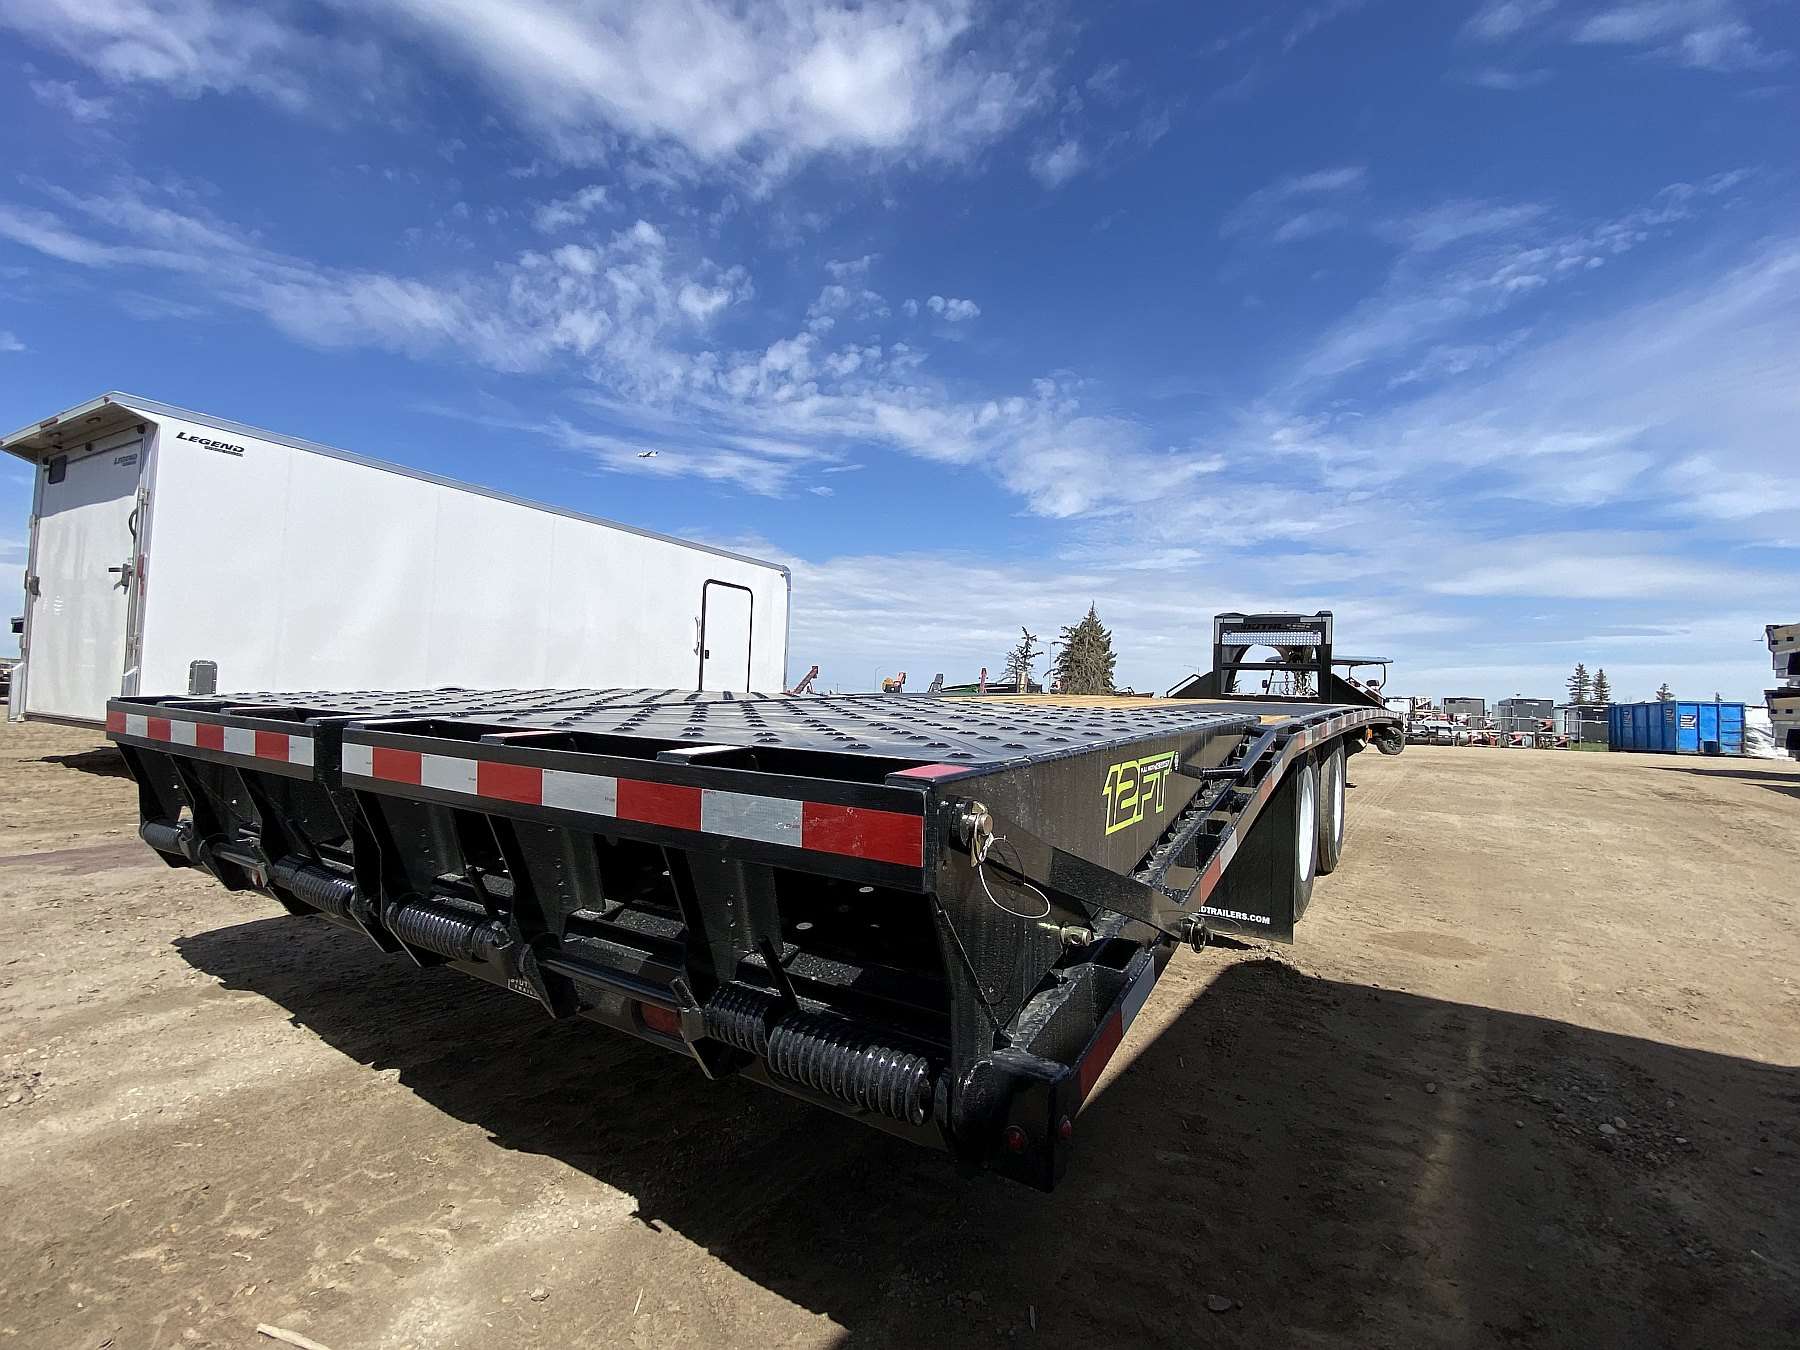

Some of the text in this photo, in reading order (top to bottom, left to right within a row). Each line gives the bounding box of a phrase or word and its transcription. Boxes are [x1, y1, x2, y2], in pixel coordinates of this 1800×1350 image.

[176, 431, 245, 453] LEGEND
[1102, 751, 1175, 835] 12FT
[1198, 905, 1271, 925] DTRAILERS.COM
